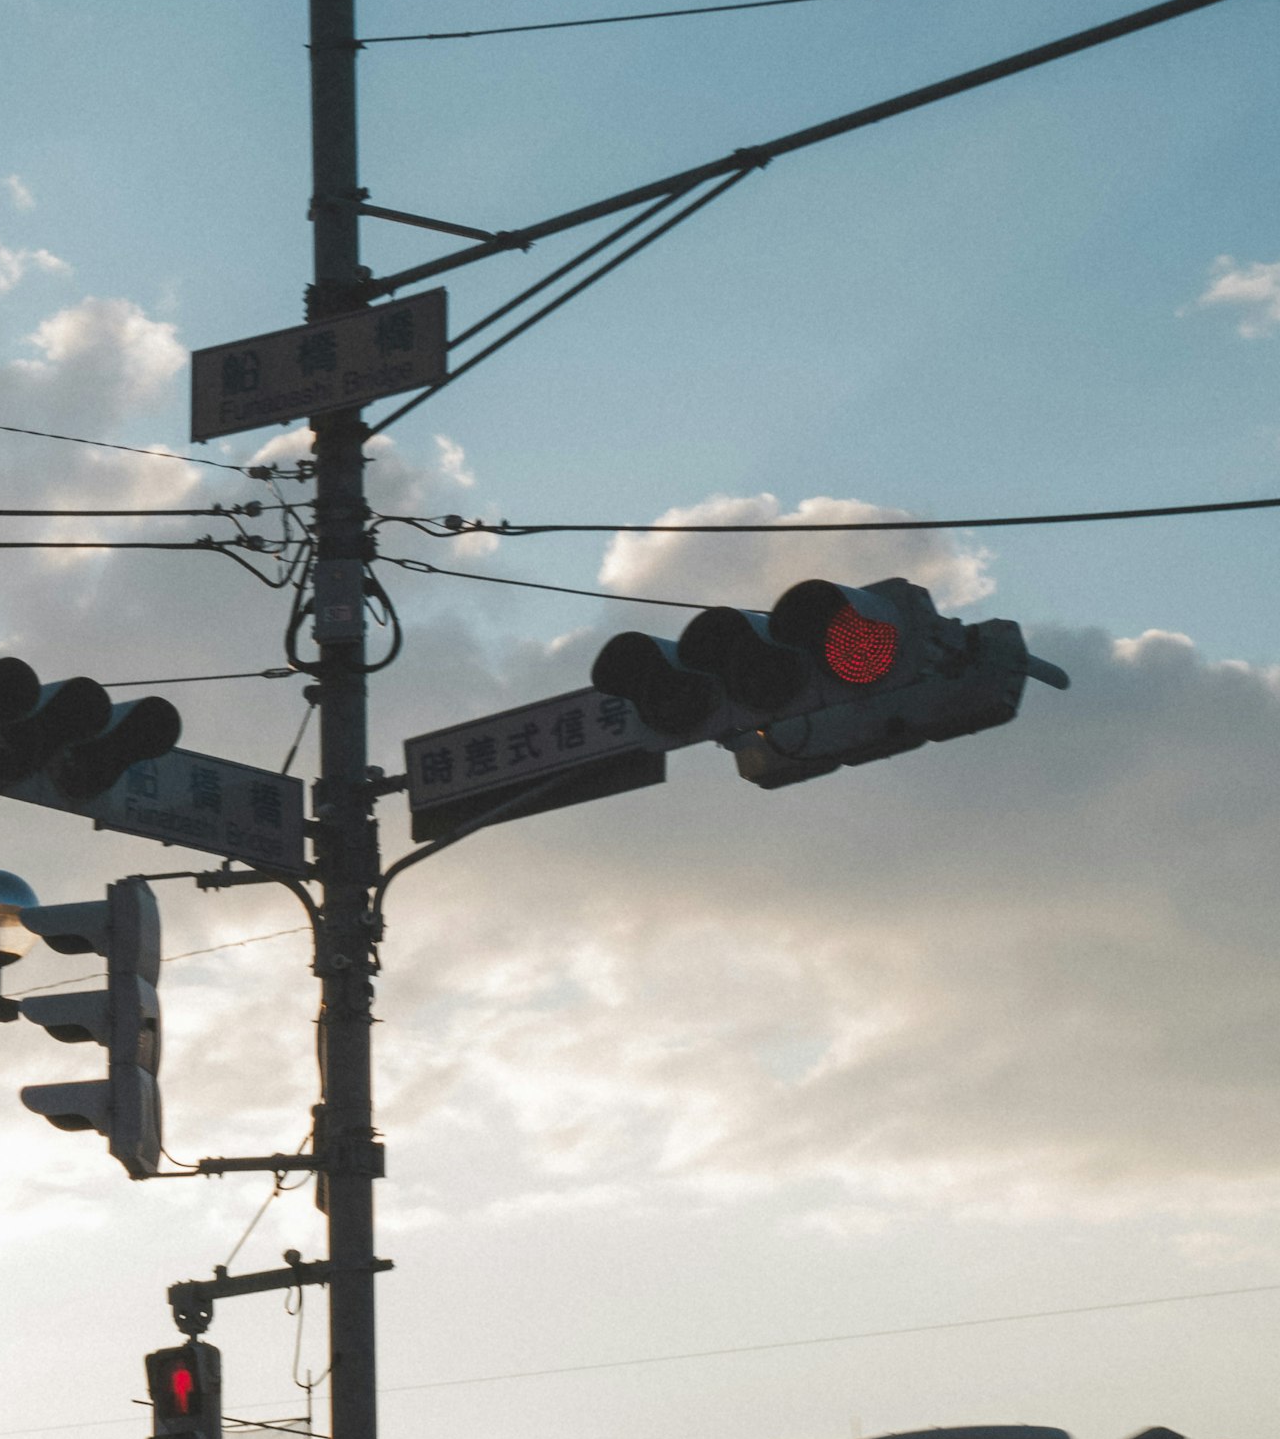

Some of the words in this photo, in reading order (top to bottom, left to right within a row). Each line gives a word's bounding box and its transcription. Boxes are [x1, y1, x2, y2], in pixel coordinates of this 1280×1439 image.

[342, 361, 414, 394] Bridge
[420, 697, 633, 786] 時差式信号
